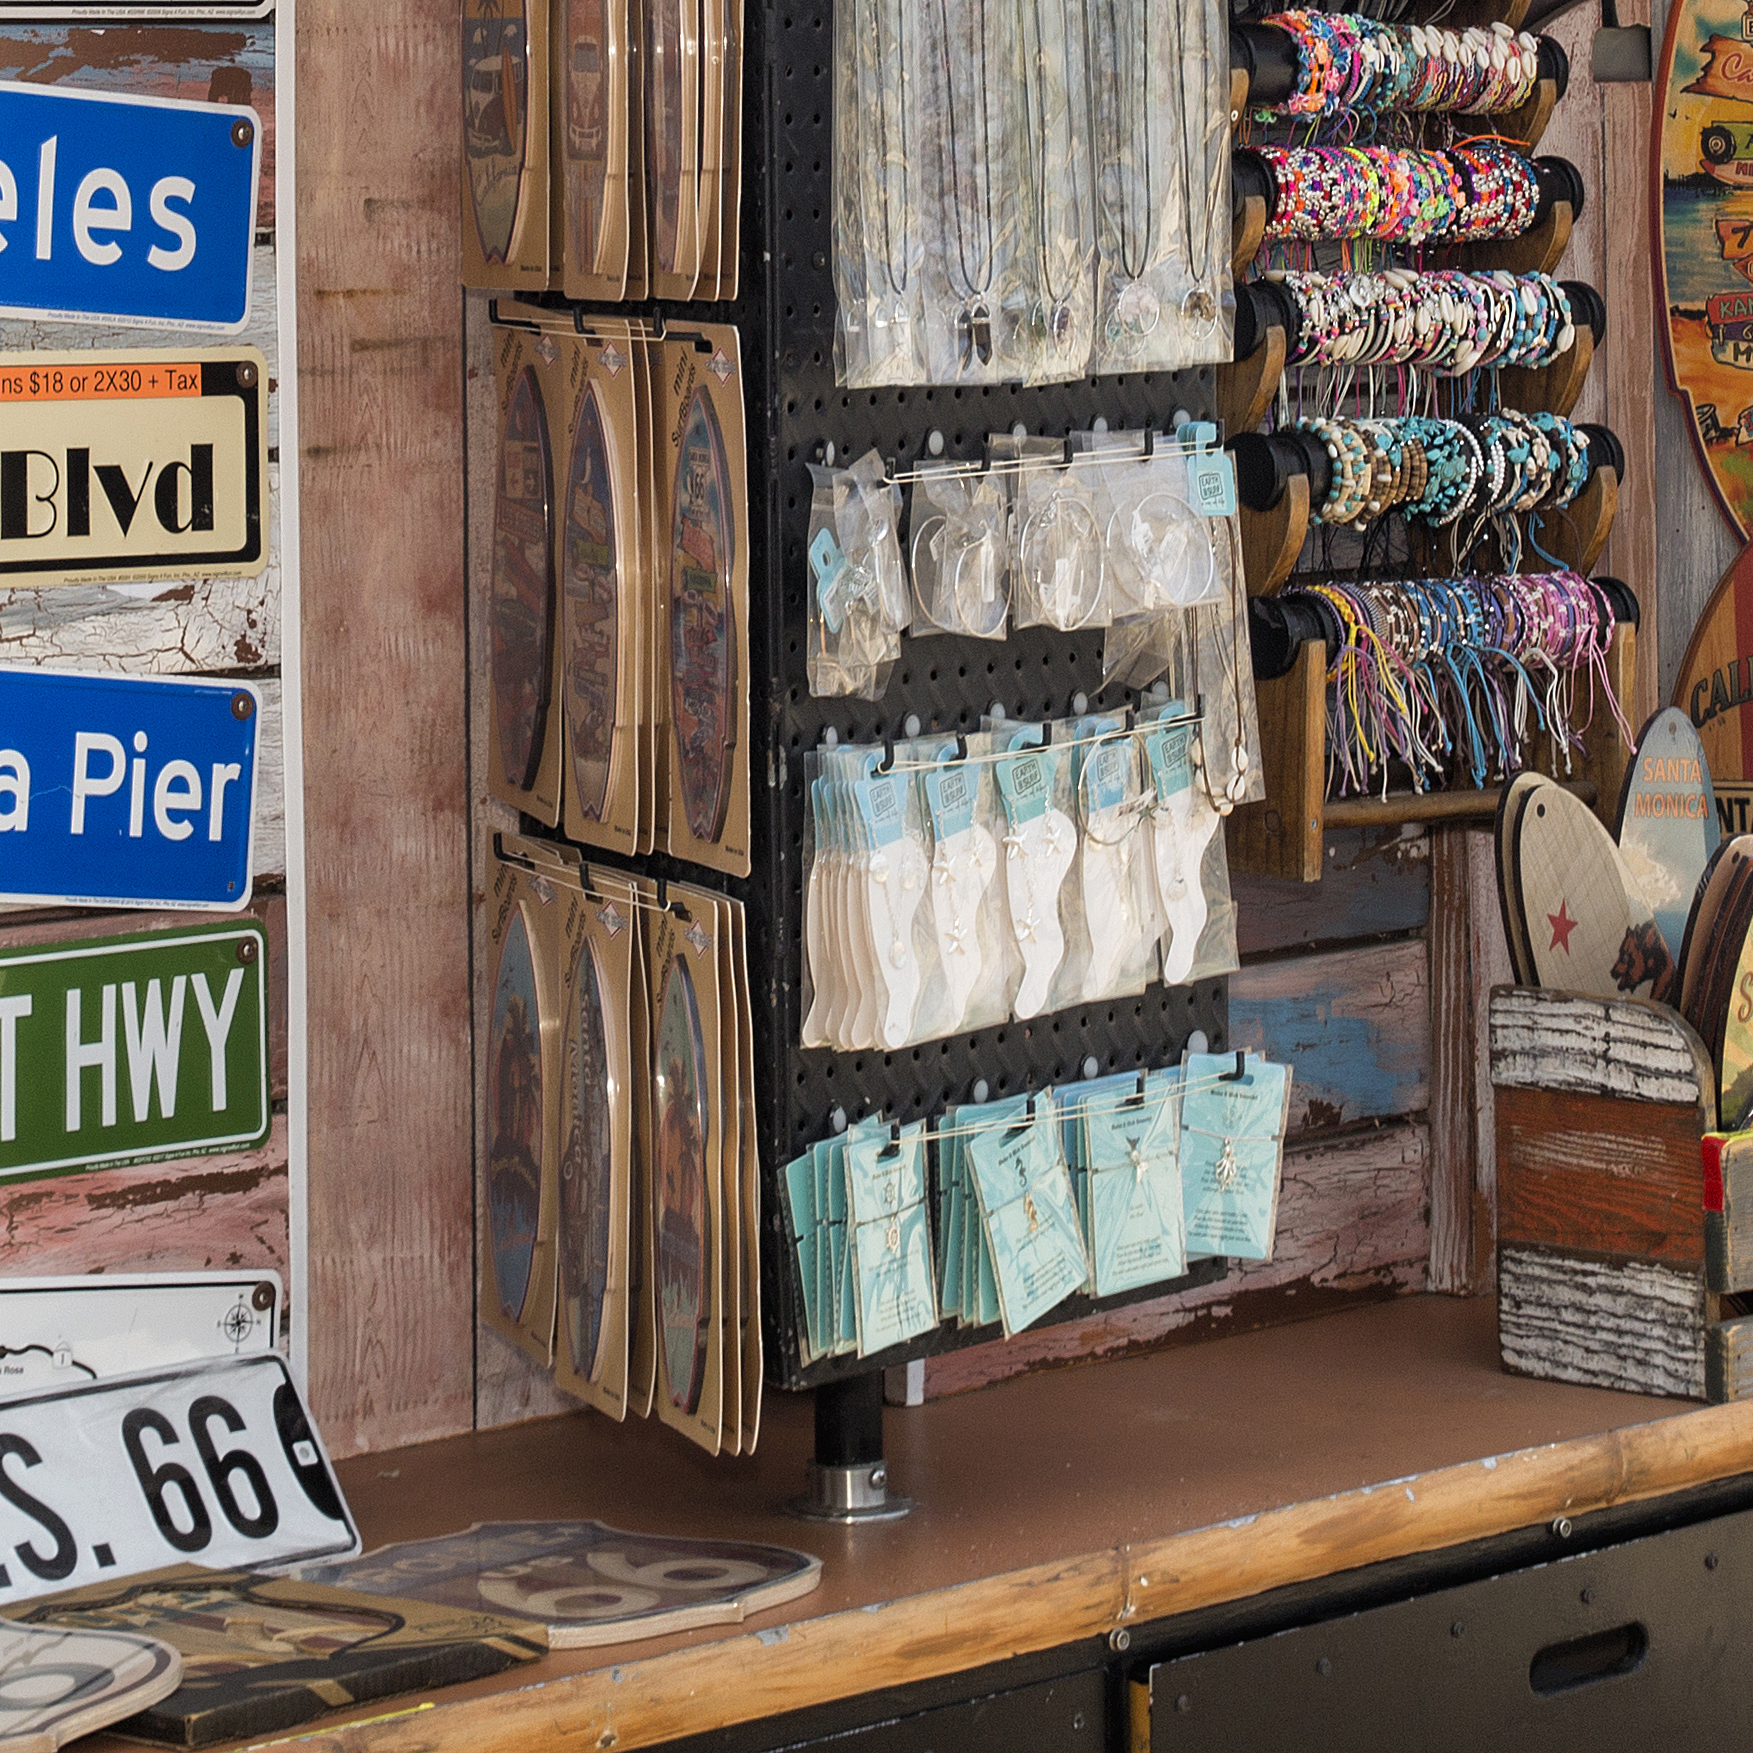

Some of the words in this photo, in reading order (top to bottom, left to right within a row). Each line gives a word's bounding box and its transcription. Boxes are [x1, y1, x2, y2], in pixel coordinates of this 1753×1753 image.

[29, 370, 65, 394] $18
[70, 375, 88, 394] or
[94, 369, 142, 393] 2X30
[164, 369, 199, 391] Tax
[0, 444, 215, 541] Blvd
[70, 730, 242, 842] Pier
[1634, 792, 1710, 821] MONICA
[1642, 756, 1703, 784] SANTA
[65, 967, 246, 1133] HWY
[122, 1395, 281, 1553] 66
